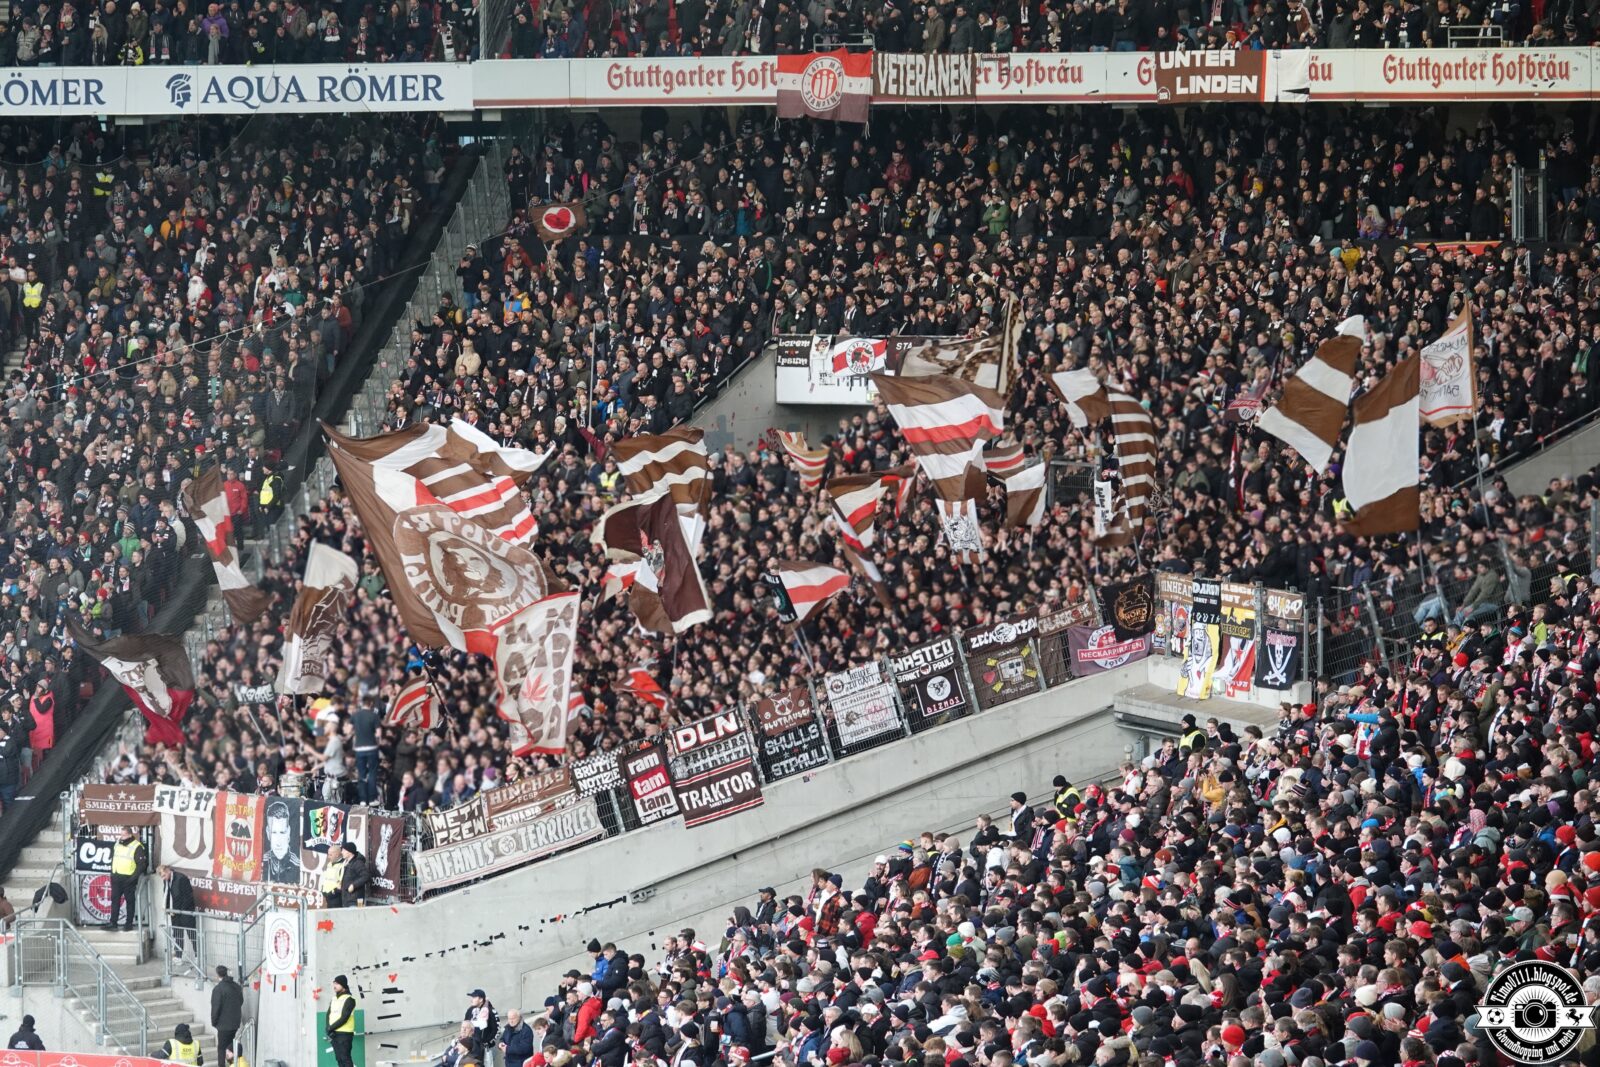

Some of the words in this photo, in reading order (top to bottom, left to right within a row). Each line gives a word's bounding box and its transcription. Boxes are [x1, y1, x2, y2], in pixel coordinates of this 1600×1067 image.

[1159, 50, 1236, 70] UNTER
[1383, 53, 1487, 89] Stuttgarter
[1491, 53, 1571, 86] Hofbräu
[607, 59, 725, 94] Stuttgarter
[877, 53, 972, 97] VETERANEN
[1175, 74, 1258, 95] LINDEN
[0, 72, 106, 106] ÖMER
[201, 75, 310, 109] AQUA
[317, 67, 445, 102] RÖMER
[778, 338, 811, 348] Lorem
[777, 355, 808, 366] Ipsum
[890, 638, 954, 673] WASTED
[1080, 641, 1143, 659] NECKARPIRATEN
[1104, 656, 1124, 667] 1910
[896, 669, 921, 683] SANKT
[933, 656, 954, 672] PAULI
[677, 712, 738, 750] DLN
[765, 723, 820, 756] SKULLS
[574, 755, 619, 780] BRUTTE
[627, 751, 660, 775] ram
[489, 770, 565, 805] HINCHAS
[578, 769, 620, 792] NOTIZIE
[633, 771, 665, 796] tam
[678, 771, 756, 811] TRAKTOR
[85, 801, 122, 811] SMILEY
[517, 791, 538, 803] FCSP
[640, 791, 671, 813] tam
[430, 798, 482, 831] METT
[640, 812, 661, 825] Sankt
[421, 839, 495, 883] ENFANTS
[517, 801, 598, 853] TERRIBLES
[436, 817, 488, 846] CREW
[217, 880, 257, 896] WESTEN
